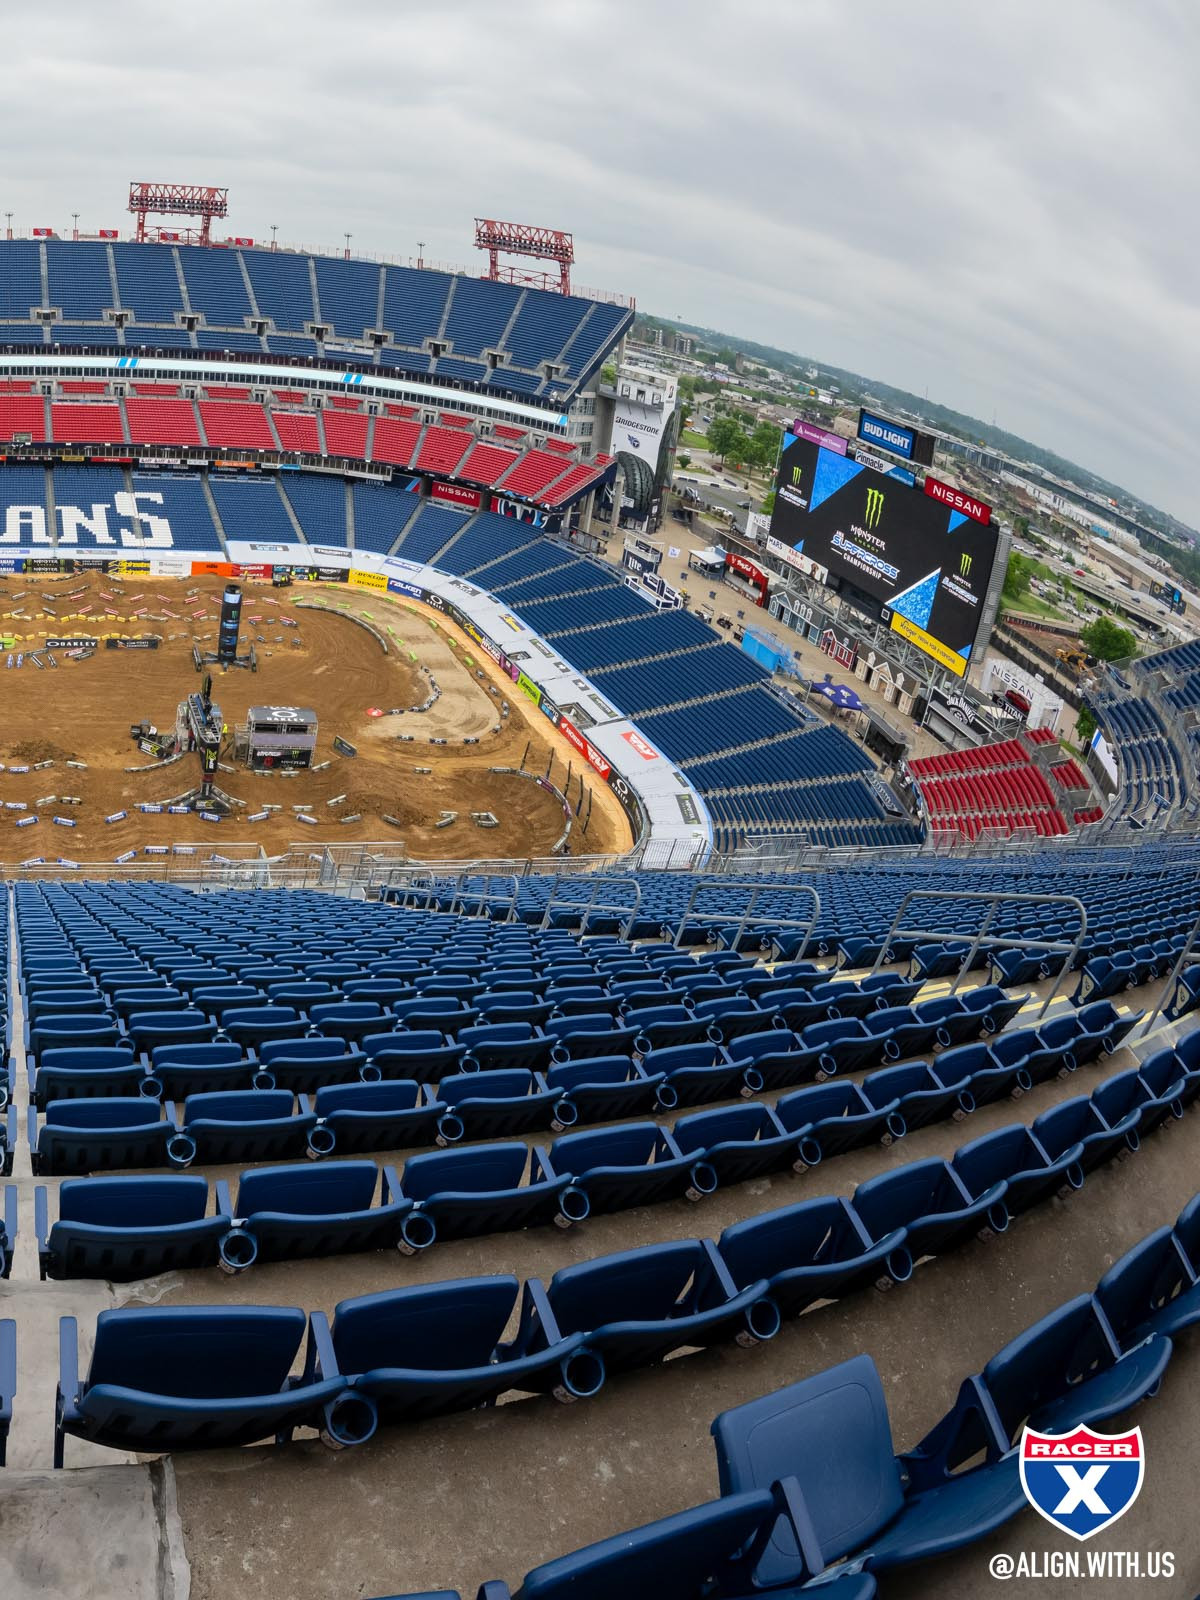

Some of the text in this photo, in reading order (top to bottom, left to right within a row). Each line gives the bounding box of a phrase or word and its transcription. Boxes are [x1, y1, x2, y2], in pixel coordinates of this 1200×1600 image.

[615, 416, 659, 435] BRIDGESTONE
[863, 421, 910, 449] BUD LIGHT
[856, 450, 884, 471] Pinnacle
[437, 485, 476, 500] NISSAN
[932, 485, 982, 517] NISSAN
[768, 535, 783, 550] MARS
[850, 524, 886, 551] MONSTER
[628, 556, 643, 571] Lite
[831, 534, 900, 580] SUPERCROSS
[843, 552, 882, 580] CHAMPIONSHIP
[357, 572, 386, 581] DUNLOP
[357, 580, 385, 588] DUNLOP
[390, 579, 422, 594] FALKEN
[900, 620, 917, 638] Kroger
[992, 664, 1034, 700] NISSAN
[1004, 703, 1024, 722] TITAN
[565, 727, 584, 750] HONDA
[586, 743, 610, 772] FLY
